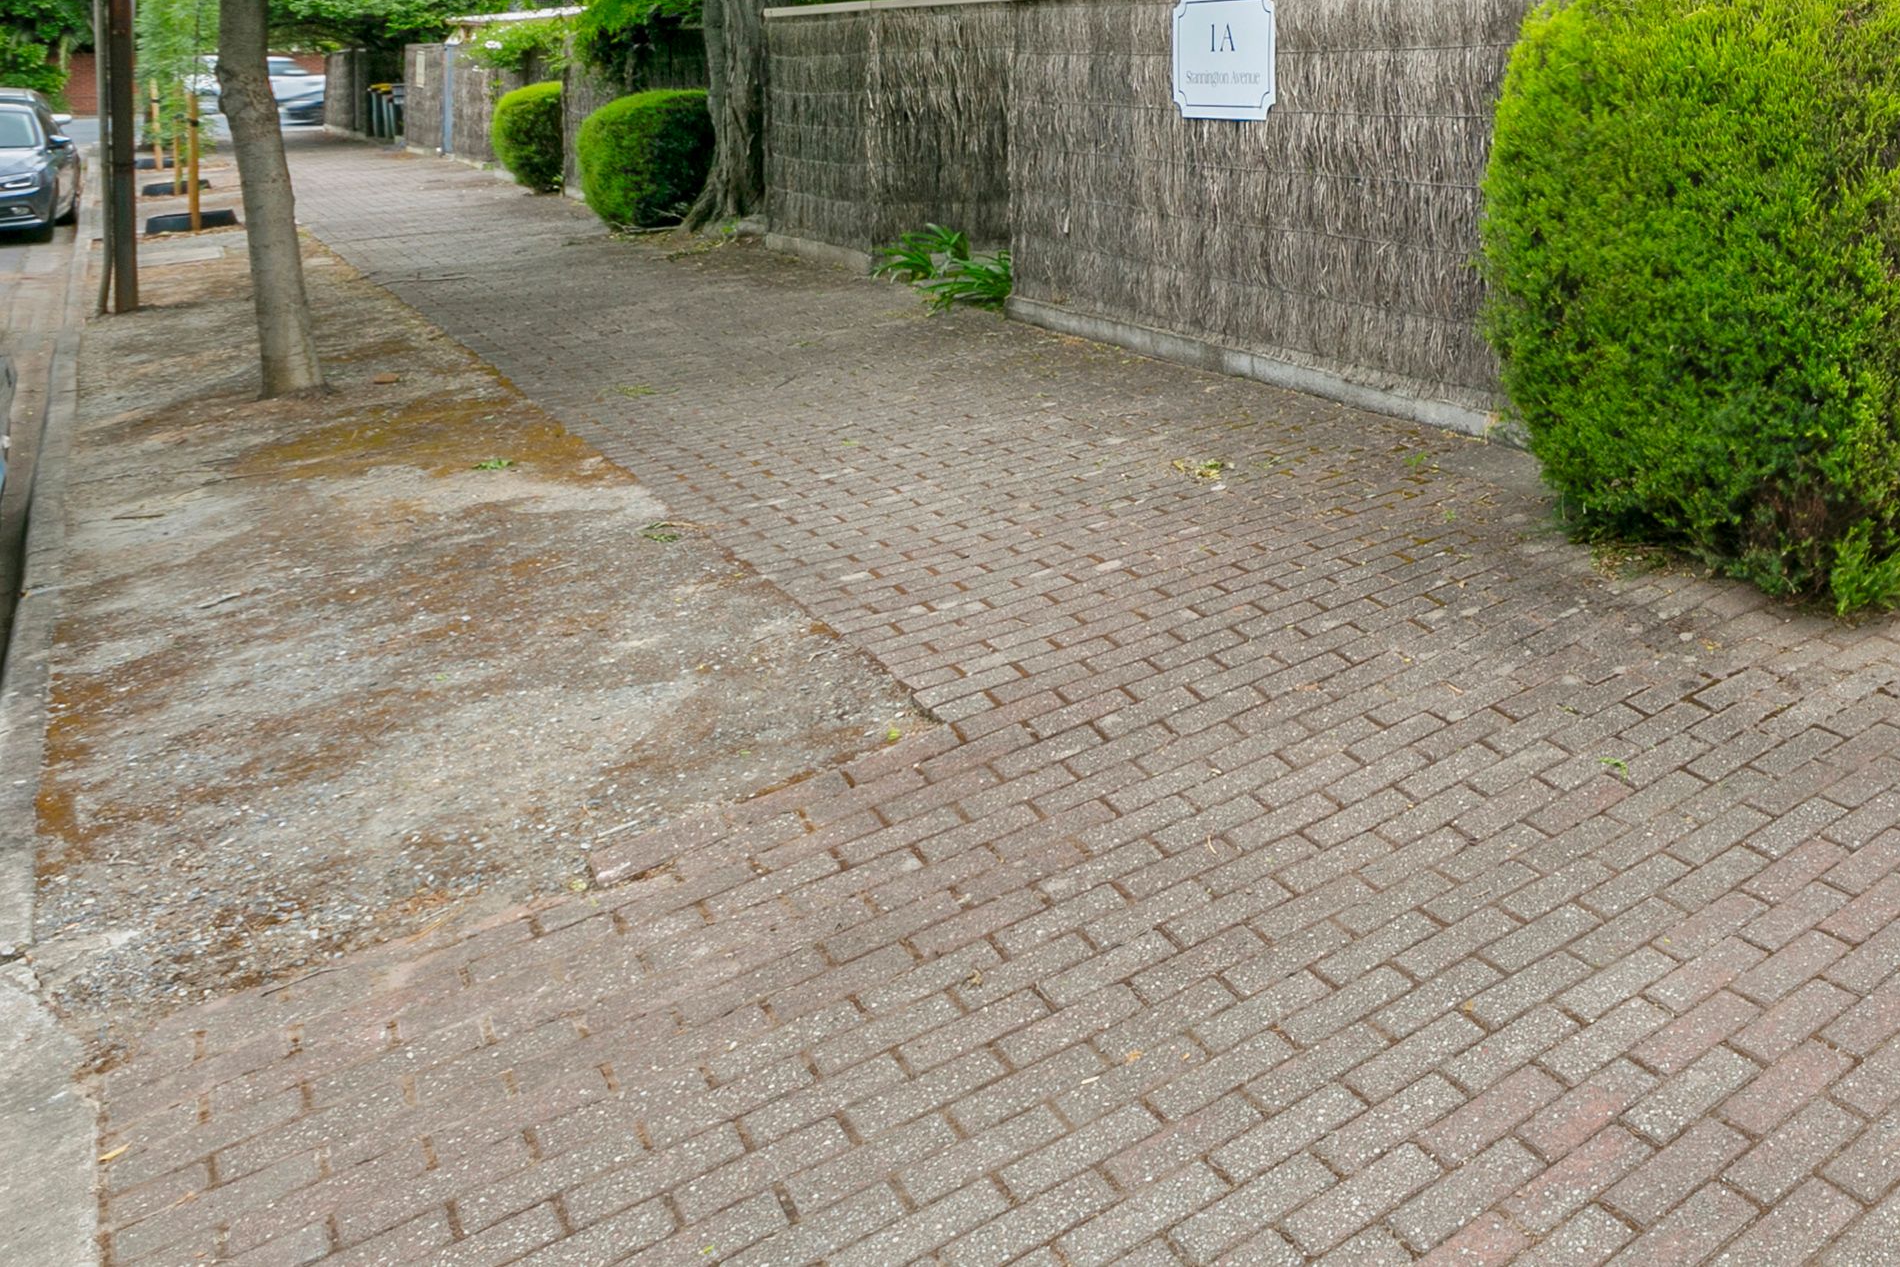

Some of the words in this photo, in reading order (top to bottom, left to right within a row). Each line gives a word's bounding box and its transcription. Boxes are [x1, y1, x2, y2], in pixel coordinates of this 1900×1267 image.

[1211, 23, 1235, 52] 1A
[1186, 70, 1229, 87] Stannington
[1231, 70, 1260, 85] Avenue
